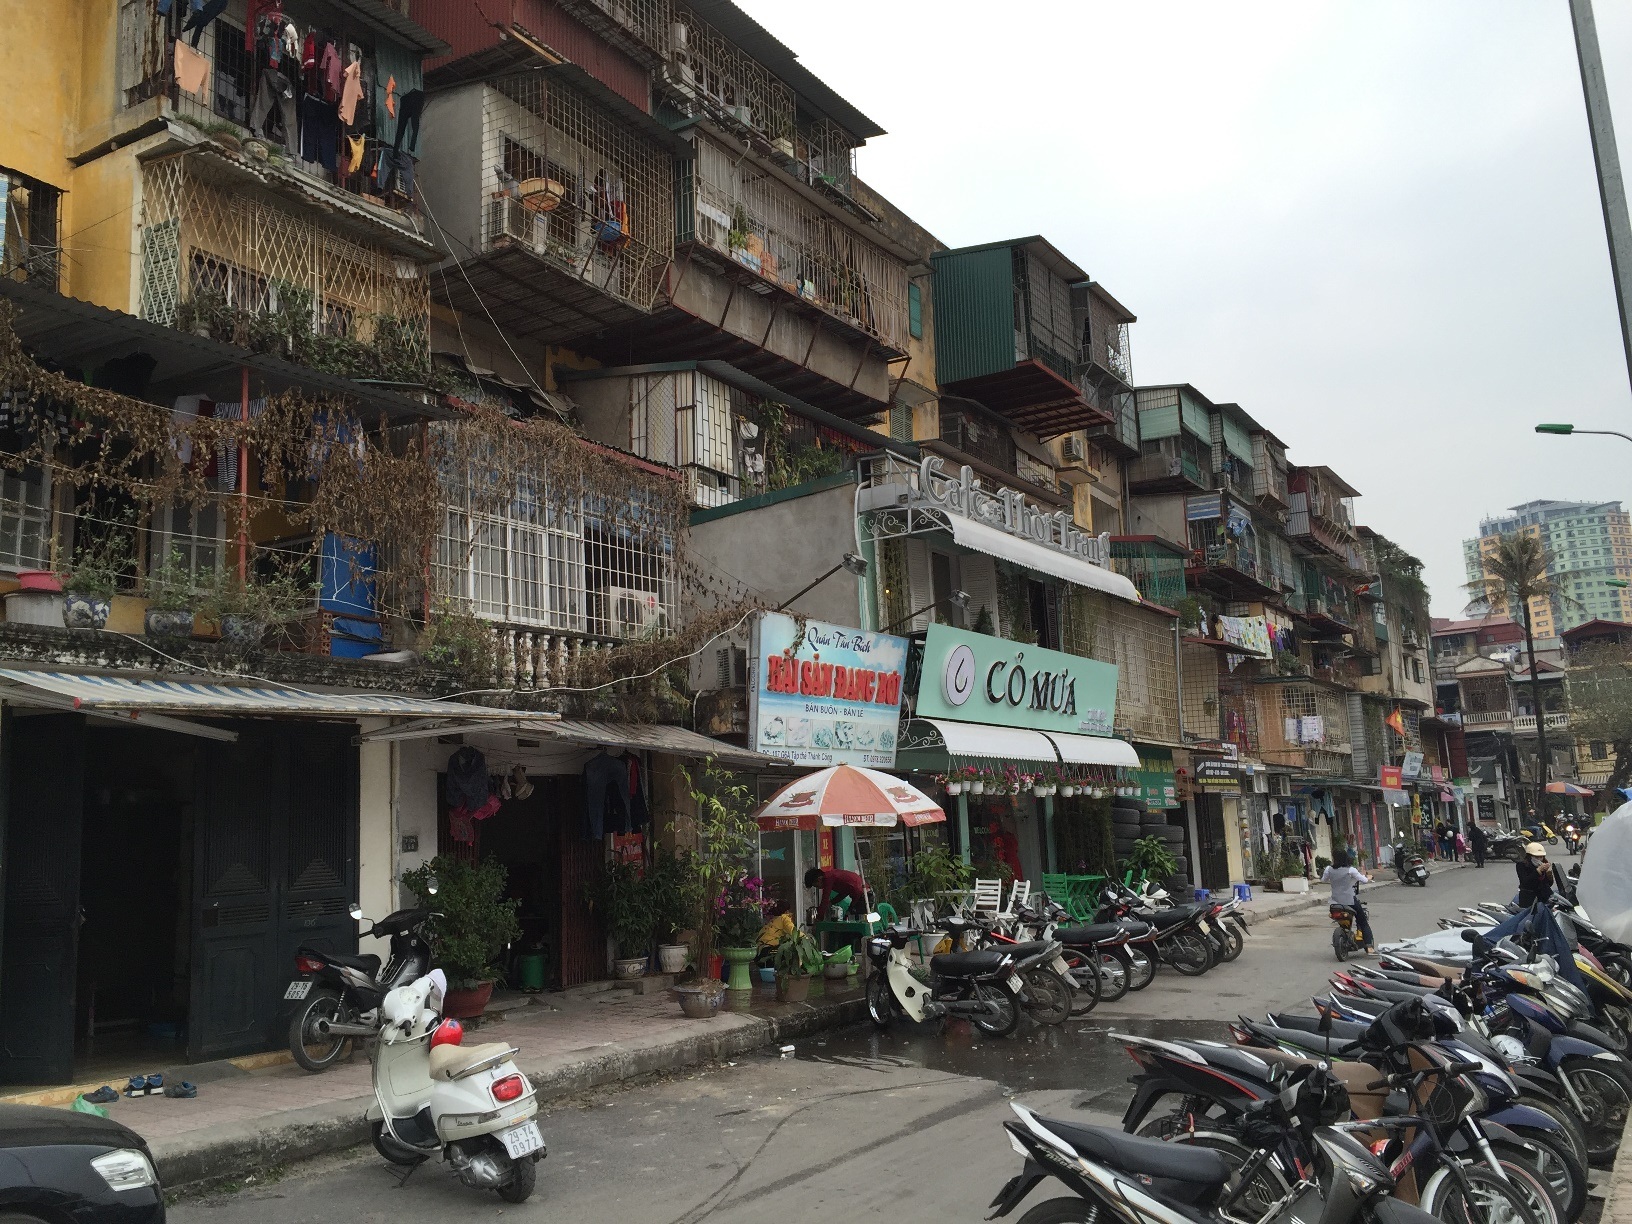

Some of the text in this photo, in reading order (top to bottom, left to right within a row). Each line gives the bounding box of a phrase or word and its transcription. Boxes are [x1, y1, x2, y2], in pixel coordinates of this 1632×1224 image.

[1054, 510, 1111, 571] Trang
[807, 626, 831, 652] Quán
[984, 652, 1078, 716] CỎ MƯA
[805, 702, 819, 713] BÁN
[820, 704, 838, 715] BUÔN
[843, 706, 856, 717] BÁN
[508, 1125, 534, 1144] 29-Y4
[512, 1137, 539, 1156] 0972
